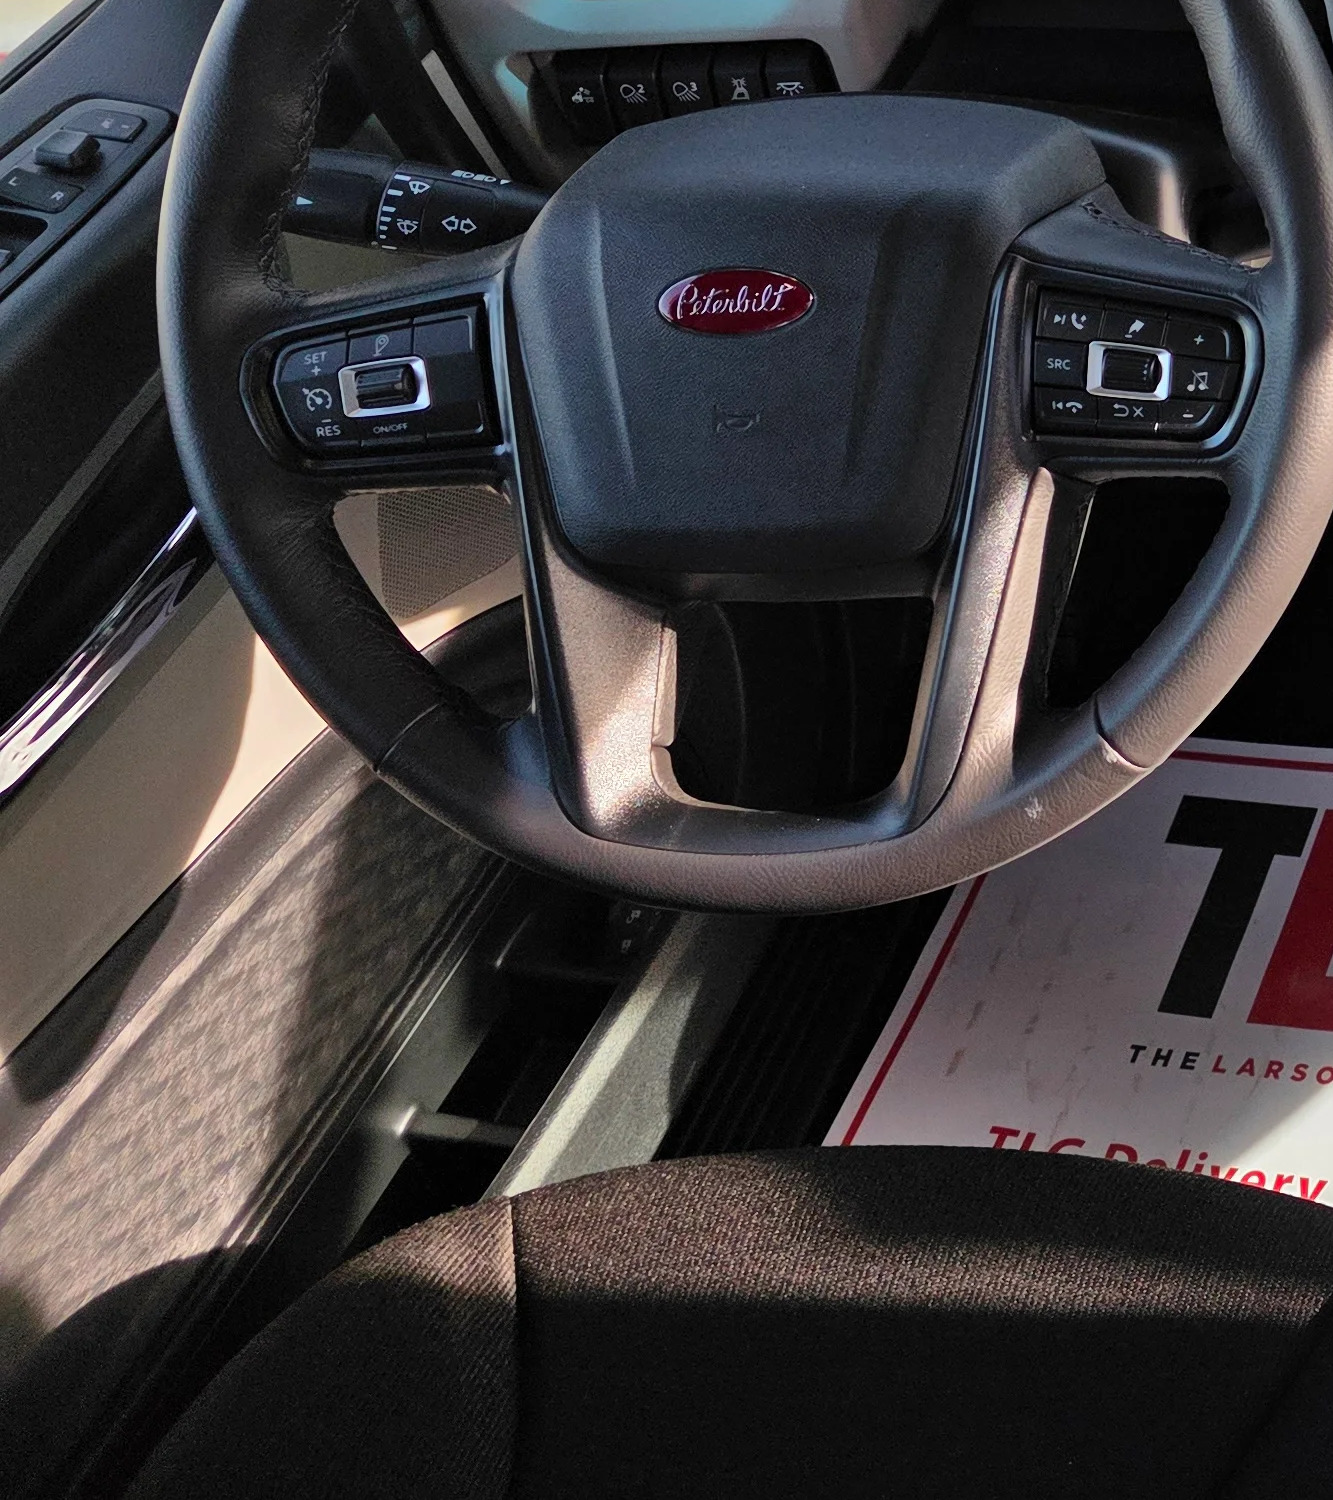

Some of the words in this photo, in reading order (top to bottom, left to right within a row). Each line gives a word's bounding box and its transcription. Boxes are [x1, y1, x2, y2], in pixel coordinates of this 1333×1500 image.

[676, 283, 797, 320] Peterbilt
[304, 351, 326, 365] SET
[1047, 358, 1071, 371] SRC
[316, 424, 341, 438] RES
[373, 422, 408, 434] ON/OFF
[1130, 1043, 1200, 1071] THE
